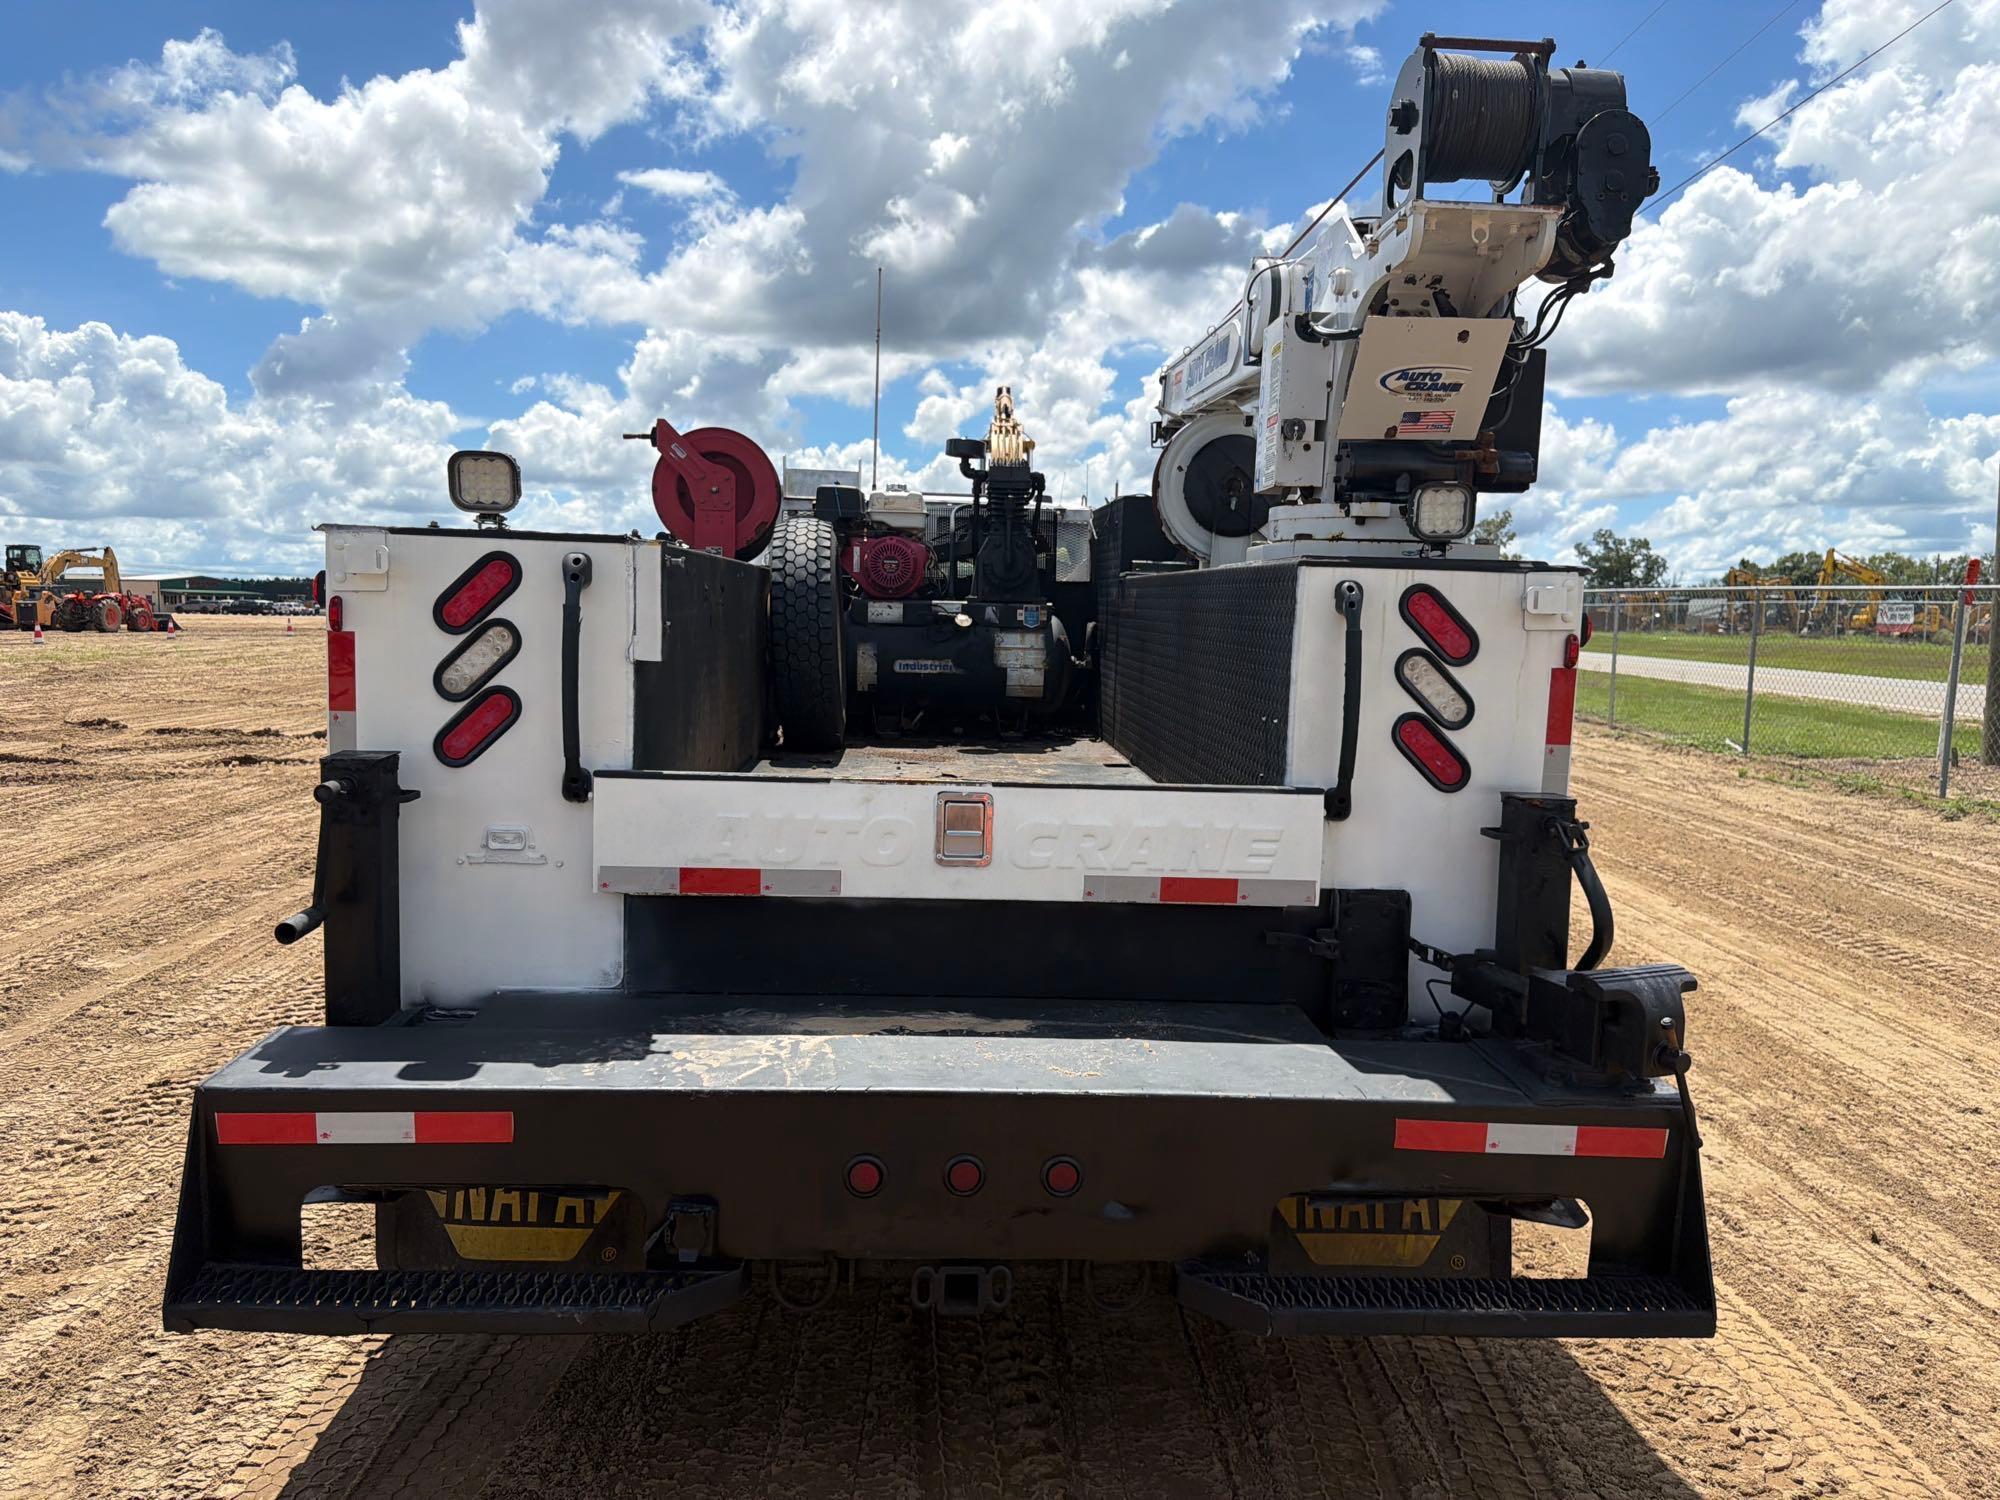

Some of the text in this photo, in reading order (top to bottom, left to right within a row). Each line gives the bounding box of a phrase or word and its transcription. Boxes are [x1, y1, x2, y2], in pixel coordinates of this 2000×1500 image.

[1394, 371, 1443, 382] AUTO
[1404, 381, 1464, 392] CRANE
[686, 813, 1285, 874] AUTO CRANE
